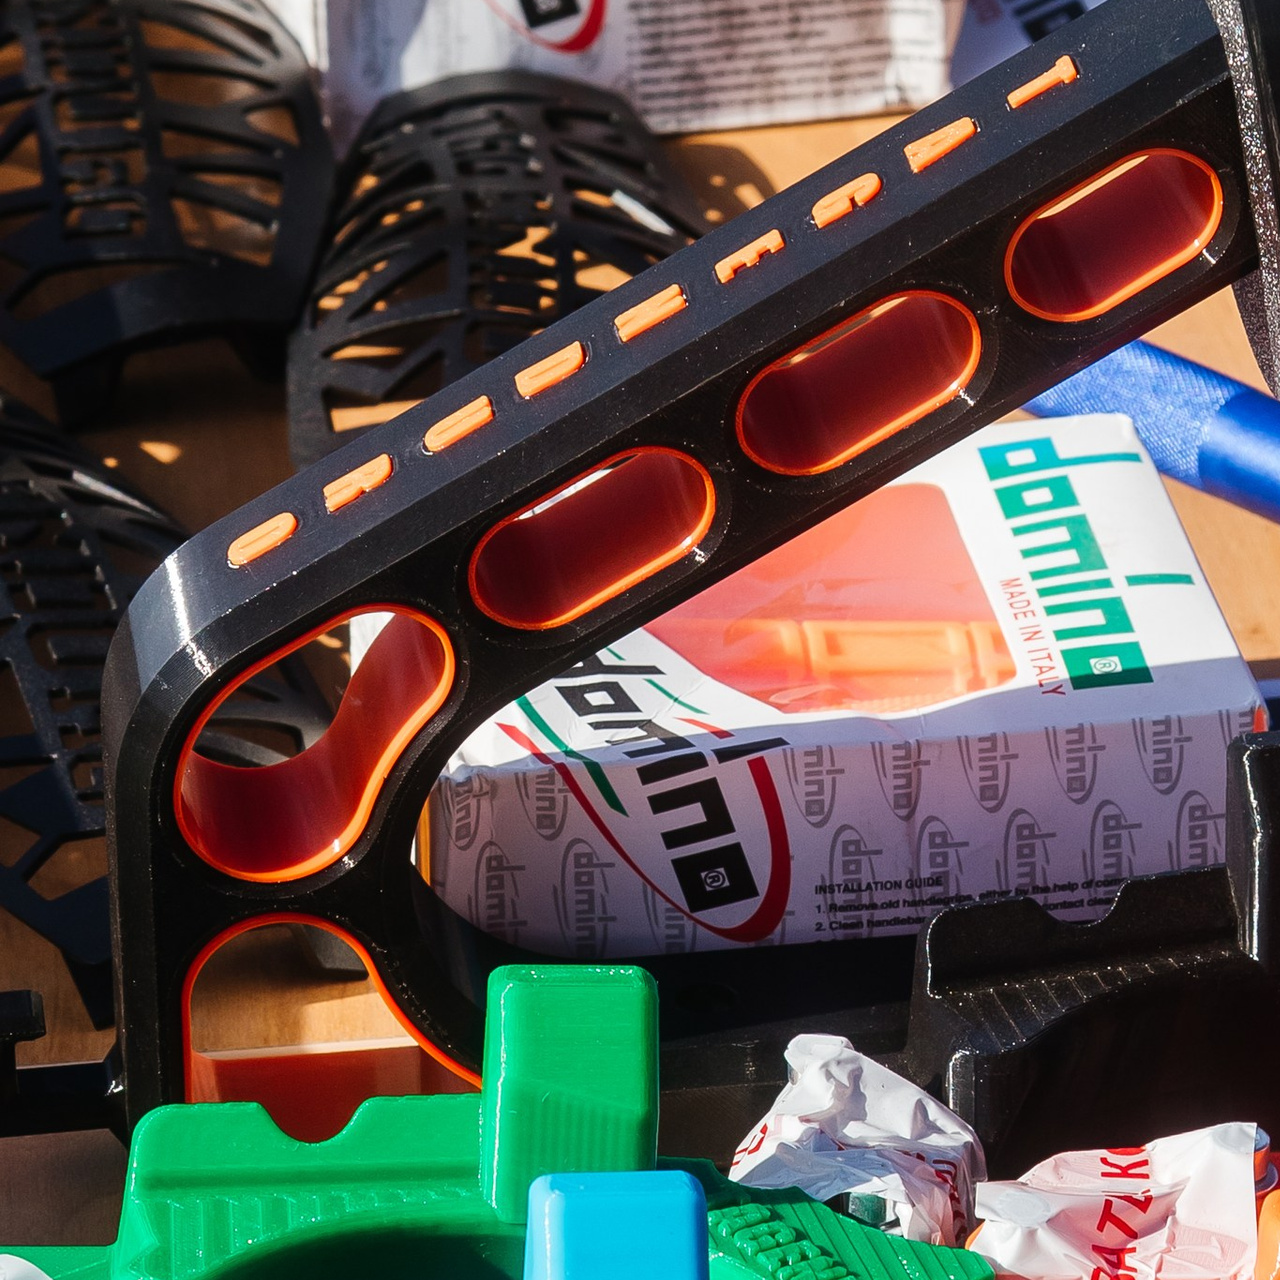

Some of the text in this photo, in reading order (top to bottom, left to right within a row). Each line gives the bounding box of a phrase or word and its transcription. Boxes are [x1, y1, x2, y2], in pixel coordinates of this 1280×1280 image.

[227, 55, 1079, 568] TAGENDURO
[978, 437, 1195, 690] domino
[1000, 577, 1067, 696] MADE IN ITALY
[553, 654, 792, 914] domino
[814, 876, 943, 895] INSTALLATION GUIDE
[829, 901, 878, 913] Remove
[880, 898, 900, 909] old
[1032, 884, 1050, 895] the
[1053, 881, 1079, 894] help
